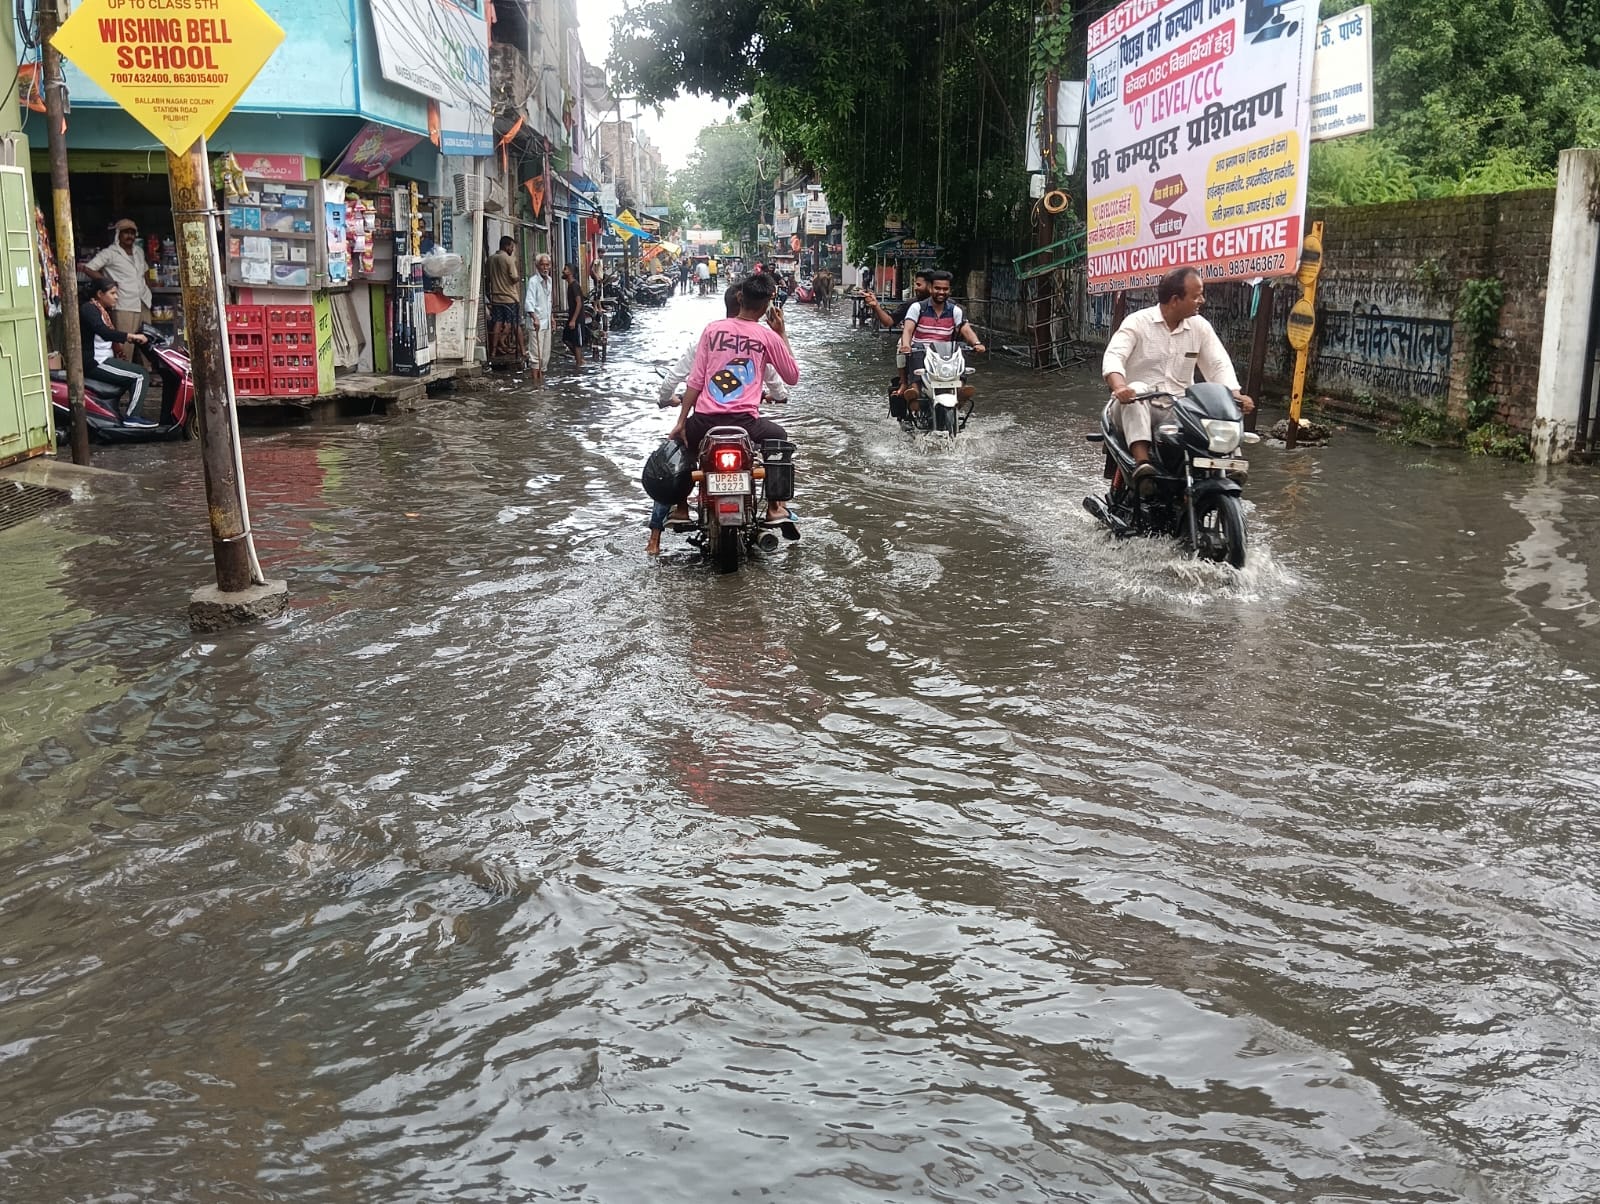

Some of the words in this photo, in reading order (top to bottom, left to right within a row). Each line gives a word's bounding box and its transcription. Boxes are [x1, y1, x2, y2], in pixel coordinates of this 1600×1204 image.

[108, 0, 127, 9] UP
[129, 0, 144, 9] TO
[149, 0, 192, 9] CLASS
[195, 0, 219, 9] 5TH
[98, 18, 182, 43] WISHING
[186, 18, 232, 43] BELL
[1147, 12, 1162, 52] वर्ग
[117, 45, 219, 70] SCHOOL
[1126, 75, 1147, 95] केवल
[1148, 62, 1169, 85] OBC
[1214, 29, 1233, 56] हेतु
[110, 73, 172, 84] 7007432400,
[173, 73, 229, 84] 8630154007
[1097, 77, 1117, 101] NIELIT
[134, 97, 165, 105] BALLABH
[166, 97, 188, 105] NAGAR
[189, 98, 215, 106] COLONY
[1152, 62, 1223, 124] LEVEL/CCC
[153, 106, 179, 114] STATION
[180, 106, 198, 114] ROAD
[162, 114, 189, 122] PILIBHIT
[1115, 126, 1180, 174] कम्प्यूटर
[1186, 82, 1287, 151] प्रशिक्षण
[1088, 252, 1128, 278] SUMAN
[1130, 237, 1208, 271] COMPUTER
[1212, 220, 1288, 258] CENTRE
[1088, 282, 1107, 293] Suman
[1205, 263, 1227, 278] Mob.
[1229, 253, 1285, 275] 9837463672
[714, 474, 744, 483] UP26A
[714, 482, 744, 491] K3273
